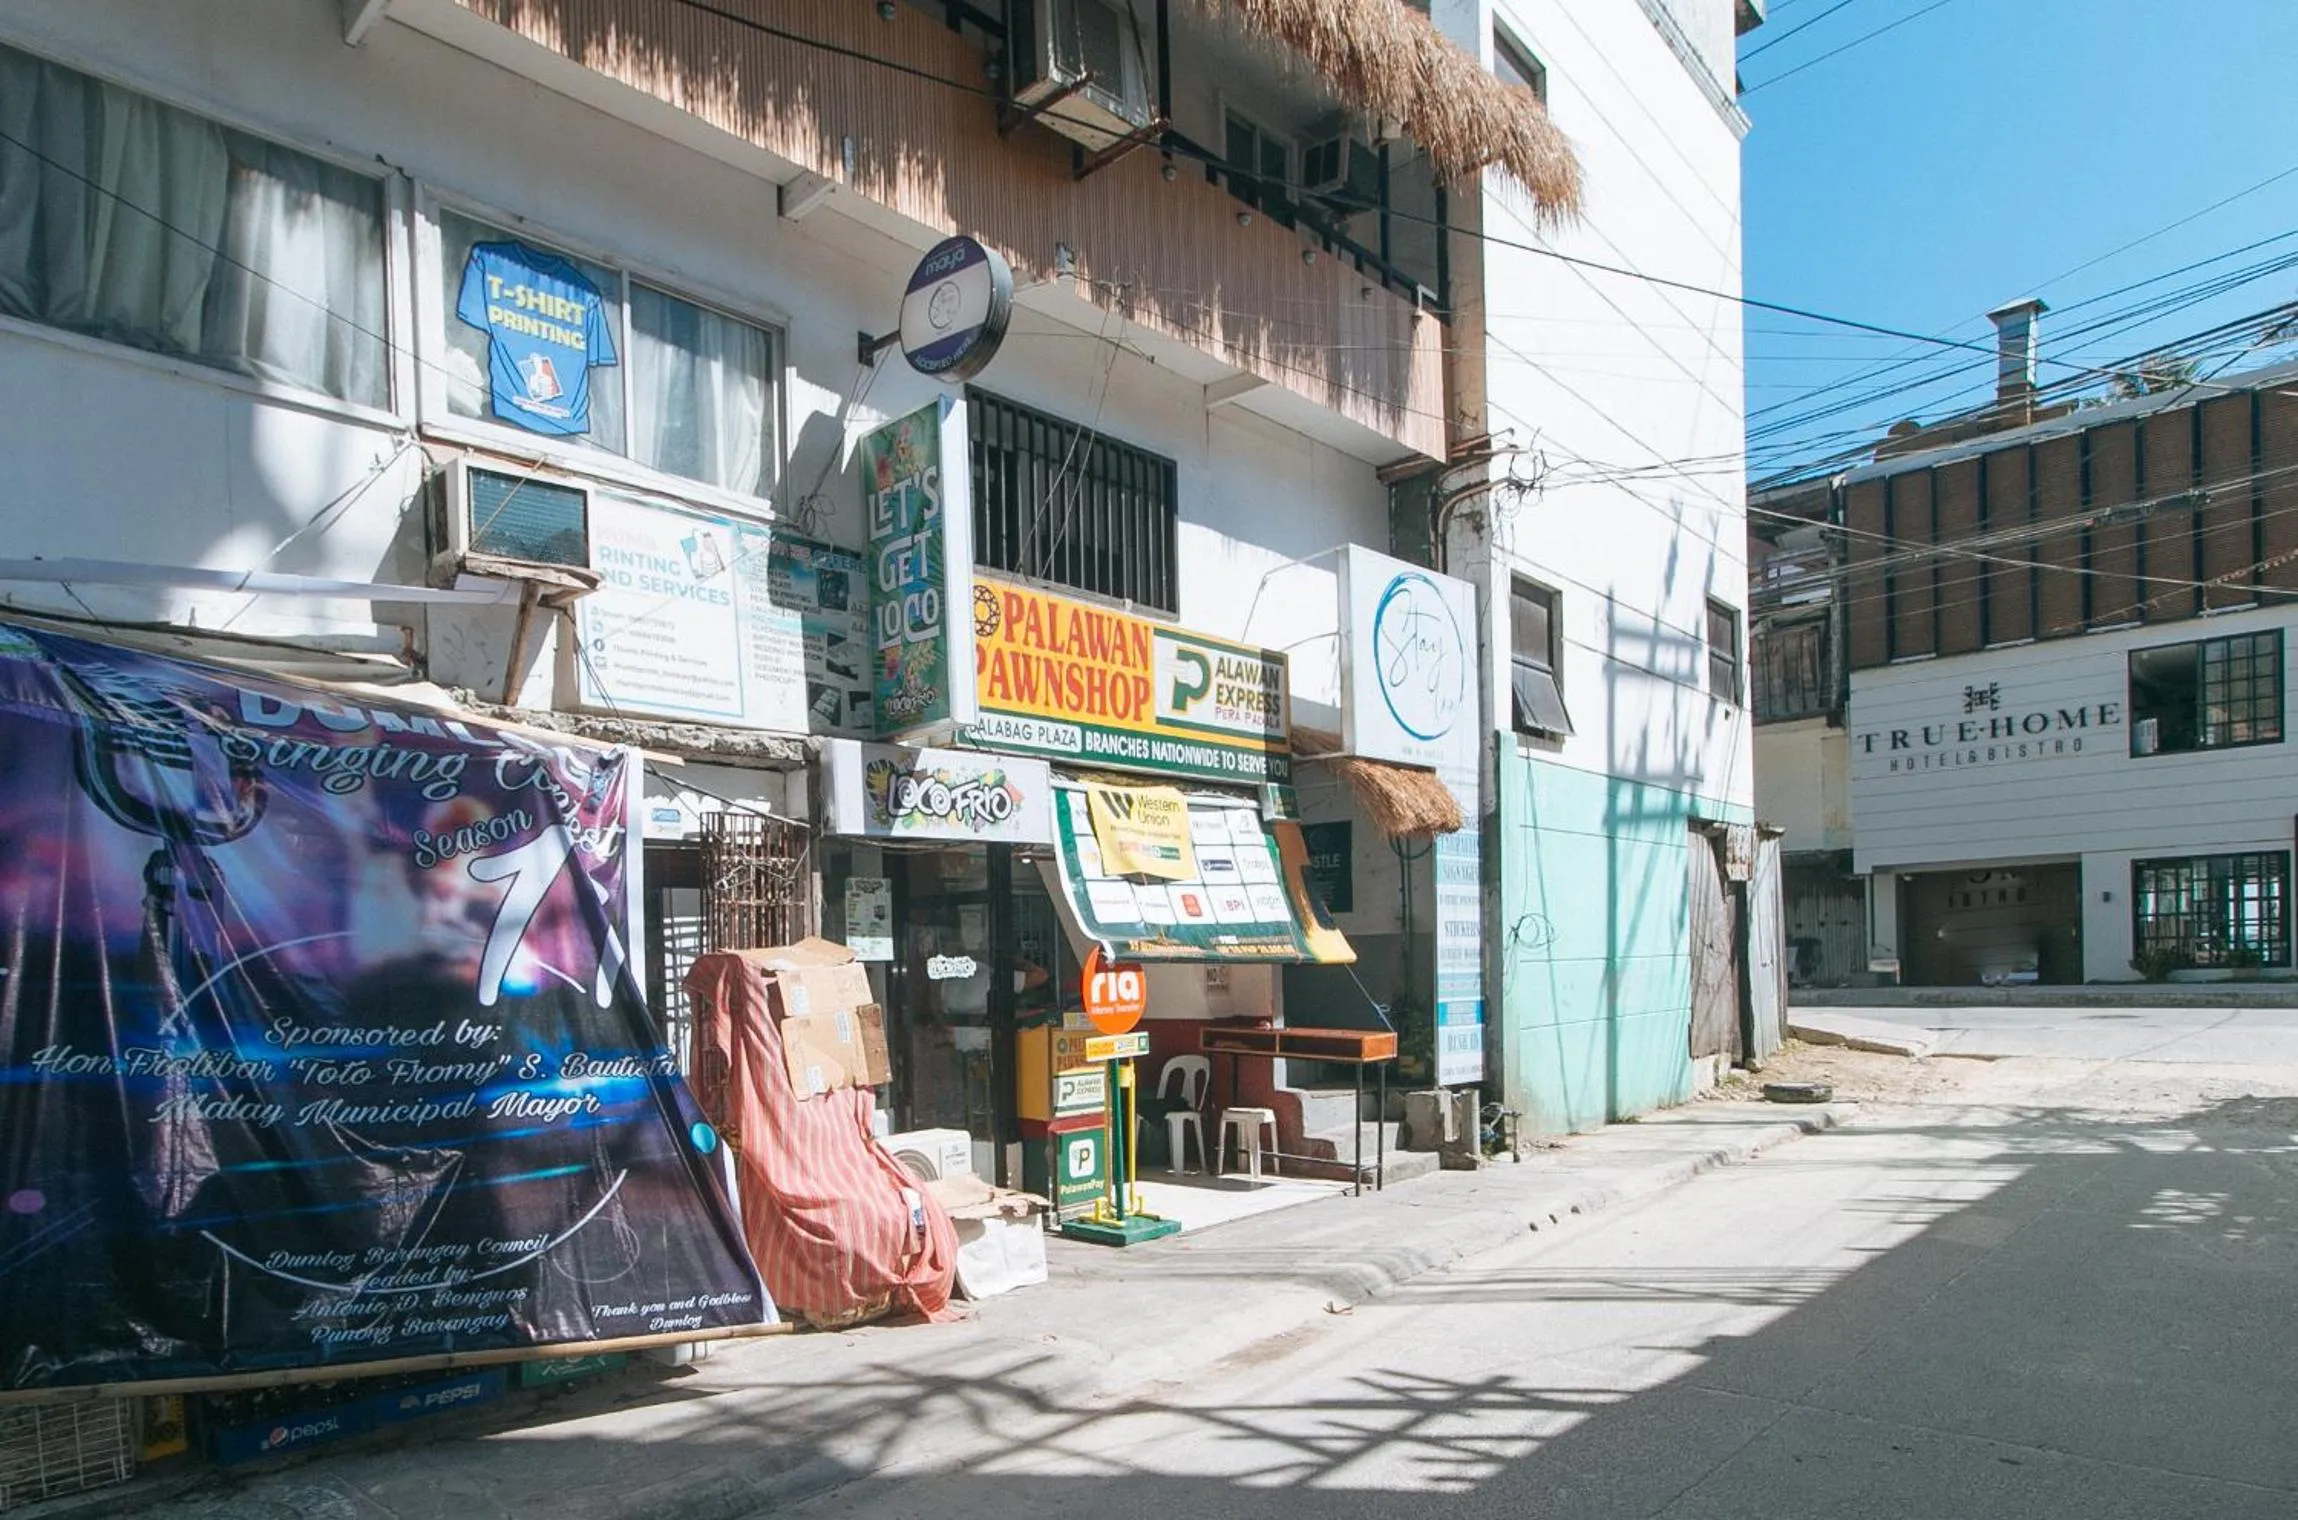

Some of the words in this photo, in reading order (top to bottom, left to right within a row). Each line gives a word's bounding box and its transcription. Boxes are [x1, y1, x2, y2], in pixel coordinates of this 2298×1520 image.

[924, 248, 966, 276] maya
[486, 273, 586, 326] T-SHIRT
[488, 304, 587, 353] PRINTING
[868, 464, 941, 542] LET'S
[599, 546, 683, 577] RINTING
[877, 530, 933, 593] GET
[602, 566, 633, 586] ND
[638, 574, 731, 606] SERVICES
[876, 587, 941, 651] LOCO
[1003, 590, 1150, 672] PALAWAN
[1214, 706, 1241, 721] PERA
[1215, 683, 1281, 716] EXPRESS
[1037, 725, 1078, 748] PLAZA
[1085, 730, 1150, 760] BRANCHES
[1151, 742, 1220, 769] NATIONWIDE
[1221, 752, 1237, 771] TO
[1237, 754, 1267, 775] SERVE
[1267, 759, 1289, 778] YOU
[221, 728, 470, 801] Singing
[1136, 792, 1181, 813] Western
[1136, 806, 1171, 826] Union
[412, 809, 533, 868] Season
[1091, 970, 1140, 1004] ria
[264, 1016, 446, 1049] Sponsored
[455, 1018, 503, 1050] by:
[288, 1056, 374, 1087] "Toto
[518, 1052, 547, 1080] S.
[559, 1051, 682, 1081] Bautista
[148, 1092, 286, 1129] Malay
[294, 1091, 477, 1129] Municipal
[487, 1091, 601, 1124] Mayor
[265, 1250, 355, 1272] Dumlog
[364, 1241, 471, 1264] Barangay
[477, 1233, 551, 1256] Council
[592, 1302, 639, 1318] Thank
[640, 1302, 666, 1317] you
[669, 1296, 695, 1310] and
[649, 1314, 703, 1331] Dumlog
[310, 1325, 394, 1346] Punong
[401, 1312, 510, 1337] Barangay
[291, 1416, 339, 1441] pepsi
